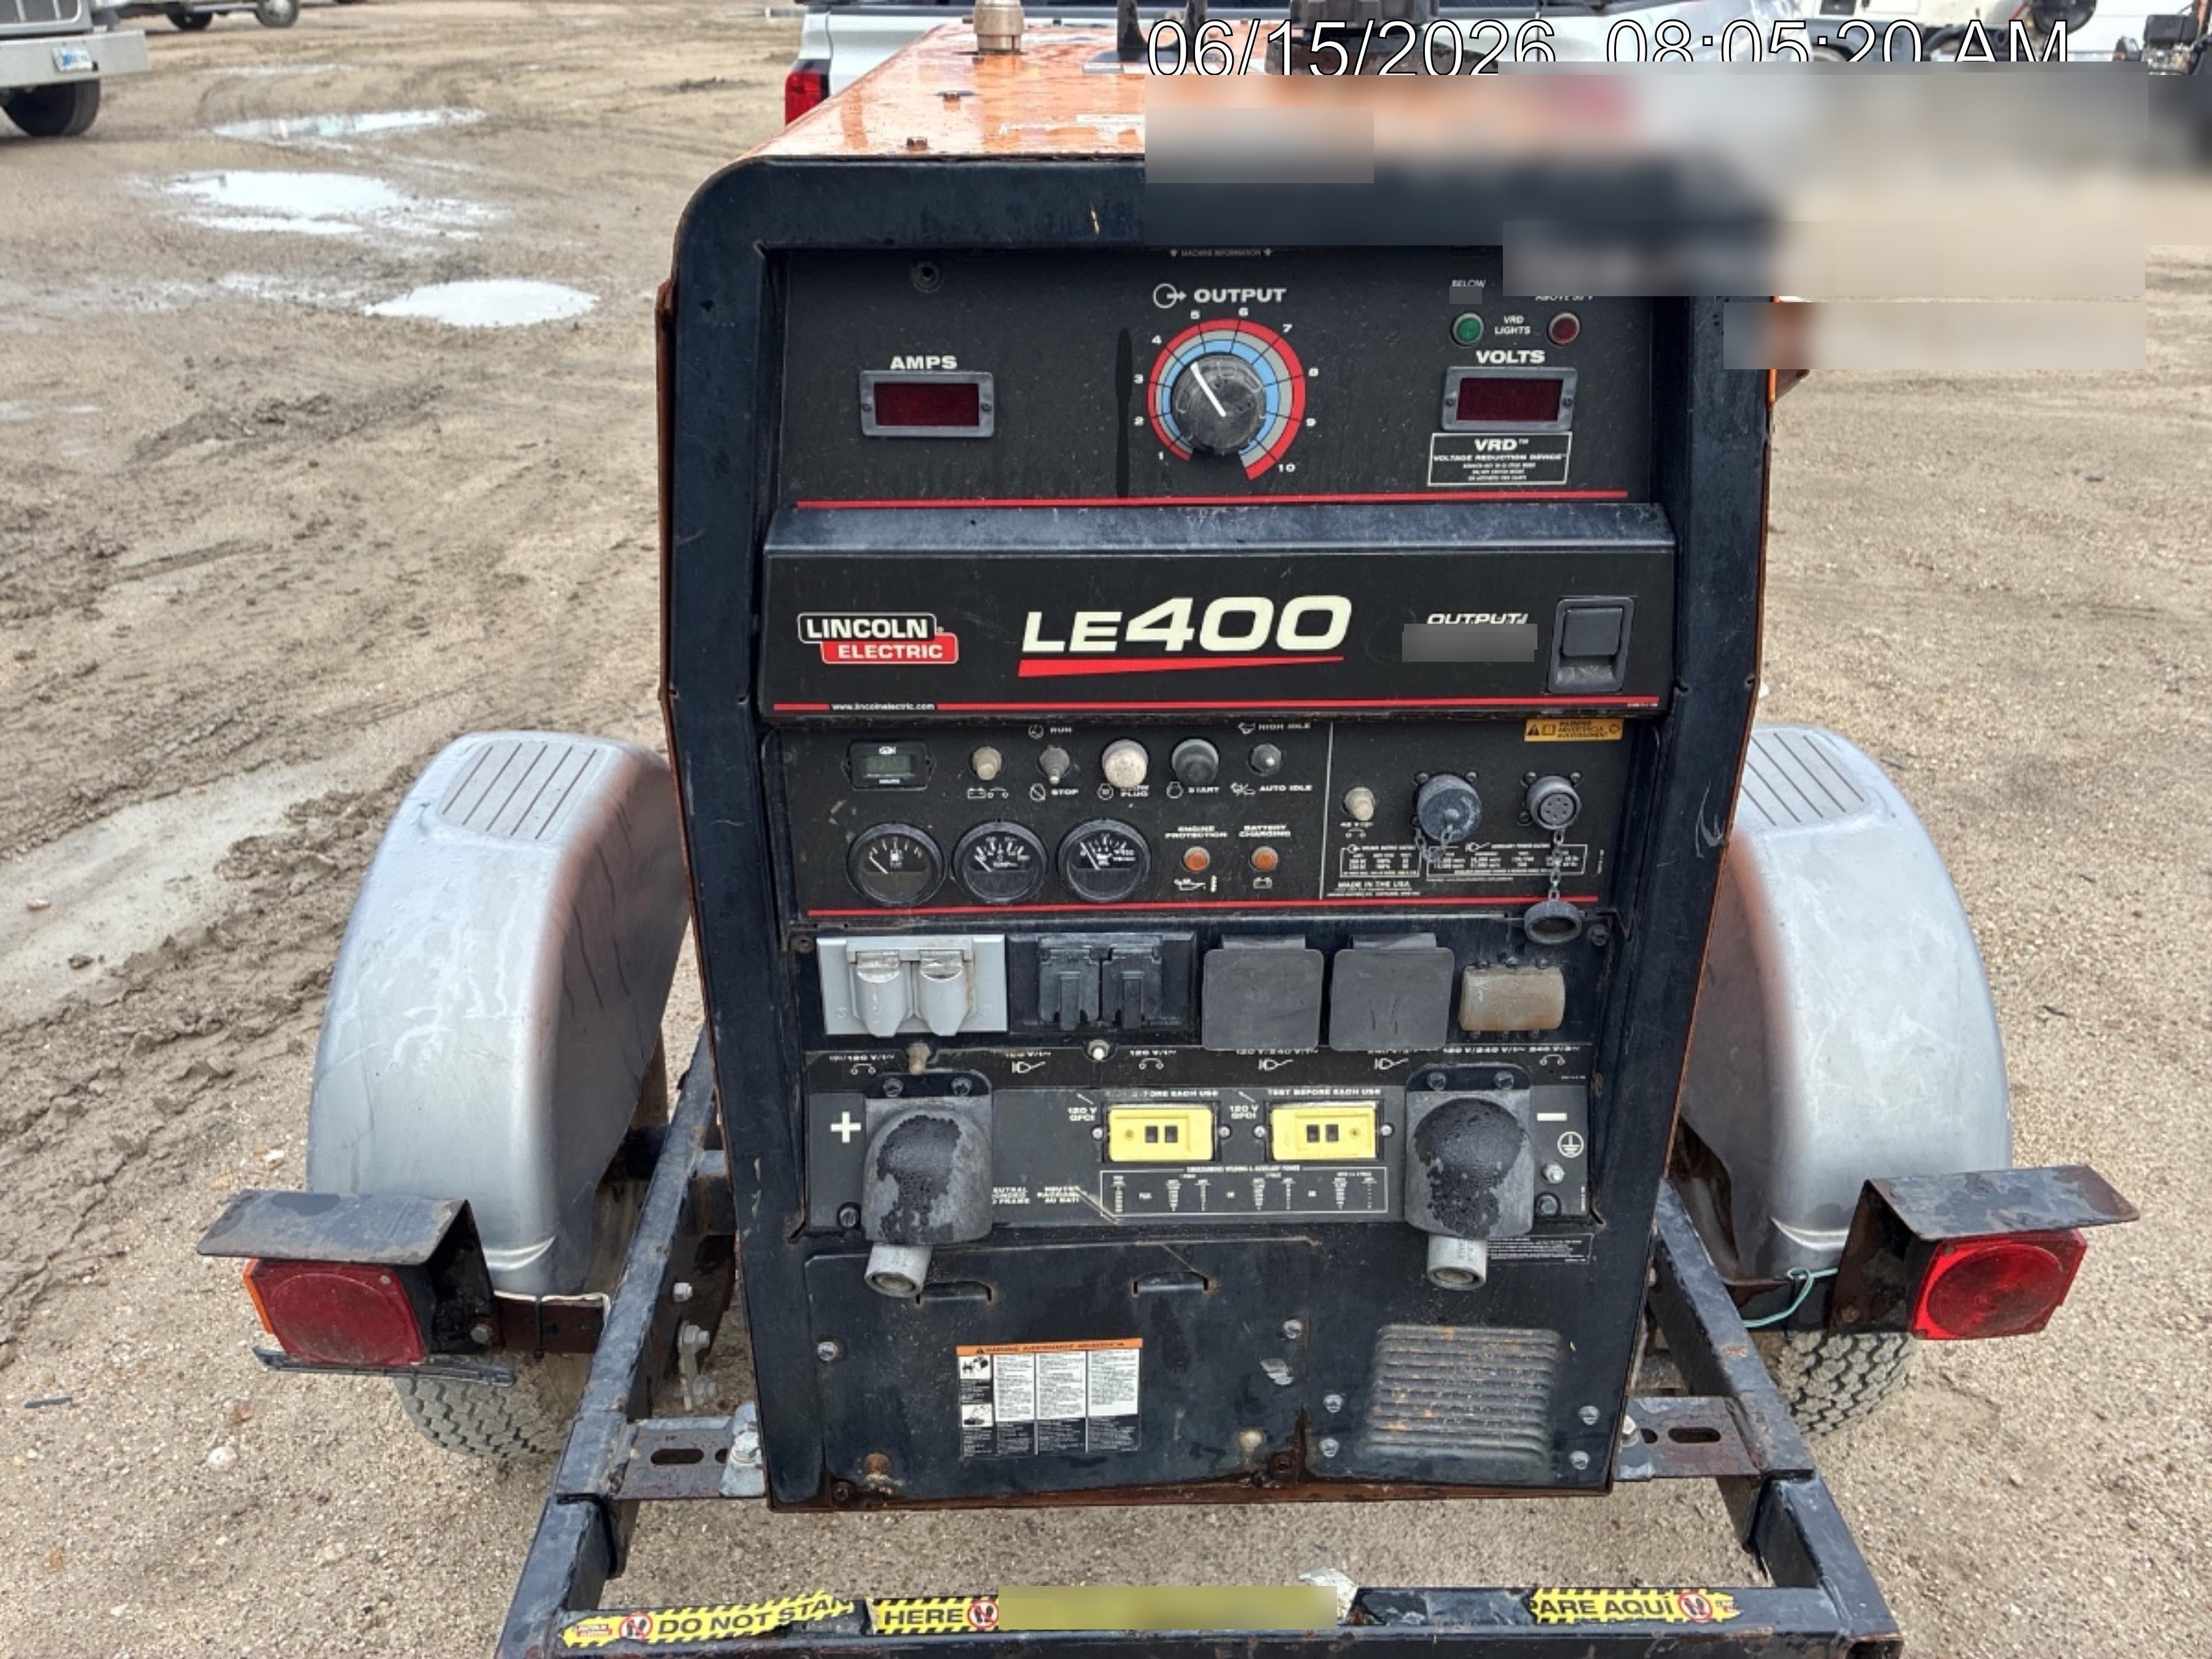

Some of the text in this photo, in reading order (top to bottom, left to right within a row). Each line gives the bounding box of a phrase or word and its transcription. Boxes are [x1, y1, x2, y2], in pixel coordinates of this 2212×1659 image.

[1194, 288, 1287, 303] OUTPUT
[1190, 310, 1200, 320] 5
[1238, 308, 1249, 316] 6
[1504, 315, 1524, 324] VRD
[1282, 324, 1293, 332] 7
[1495, 326, 1531, 335] LIGHTS
[1151, 335, 1162, 344] 4
[1476, 350, 1545, 364] VOLTS
[890, 355, 957, 370] AMPS
[1308, 369, 1319, 377] 8
[1134, 374, 1144, 383] 3
[1134, 417, 1144, 426] 2
[1306, 418, 1316, 427] 9
[1158, 452, 1164, 460] 1
[1279, 464, 1295, 473] 10
[807, 619, 928, 638] LINCOLN
[1022, 595, 1352, 653] LE400
[838, 645, 943, 659] ELECTRIC
[1605, 1596, 1674, 1615] AQUÍ
[658, 1599, 850, 1635] DO NOT STAN
[884, 1608, 963, 1625] HERE
